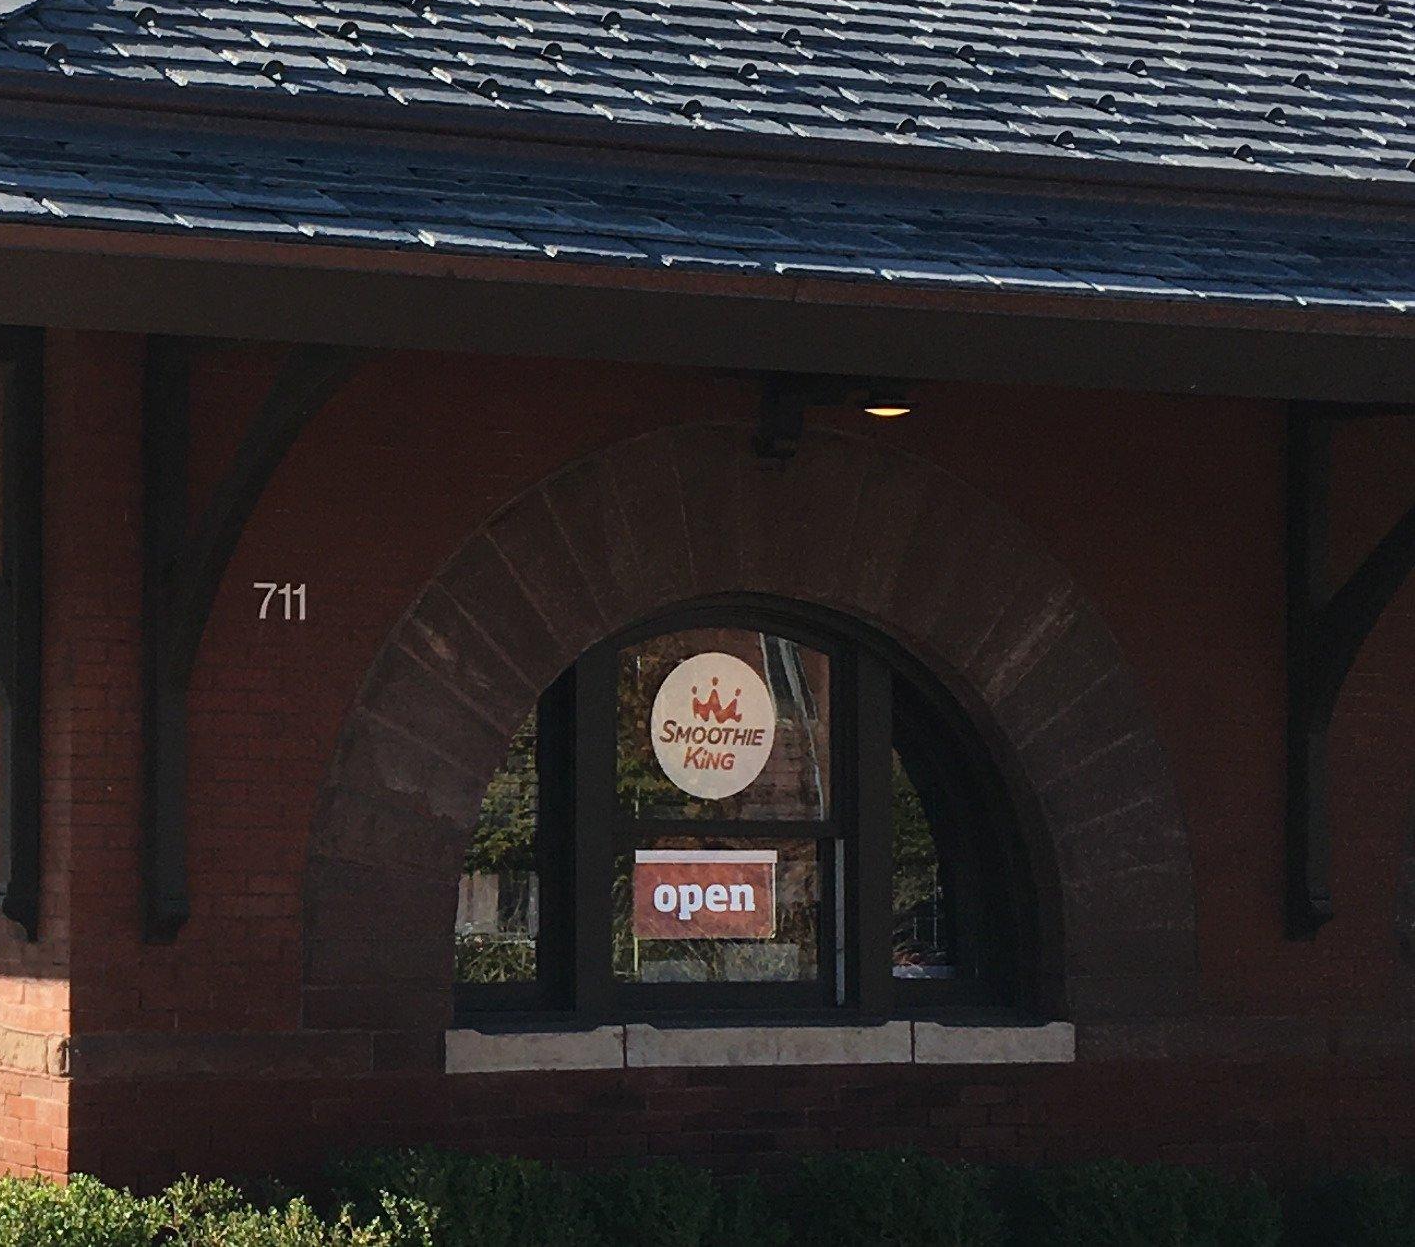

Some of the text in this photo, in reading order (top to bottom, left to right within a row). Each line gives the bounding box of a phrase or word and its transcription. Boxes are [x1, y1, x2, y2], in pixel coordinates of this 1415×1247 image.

[253, 582, 306, 620] 711
[659, 719, 766, 746] SMOOTHIE
[653, 883, 756, 921] open
